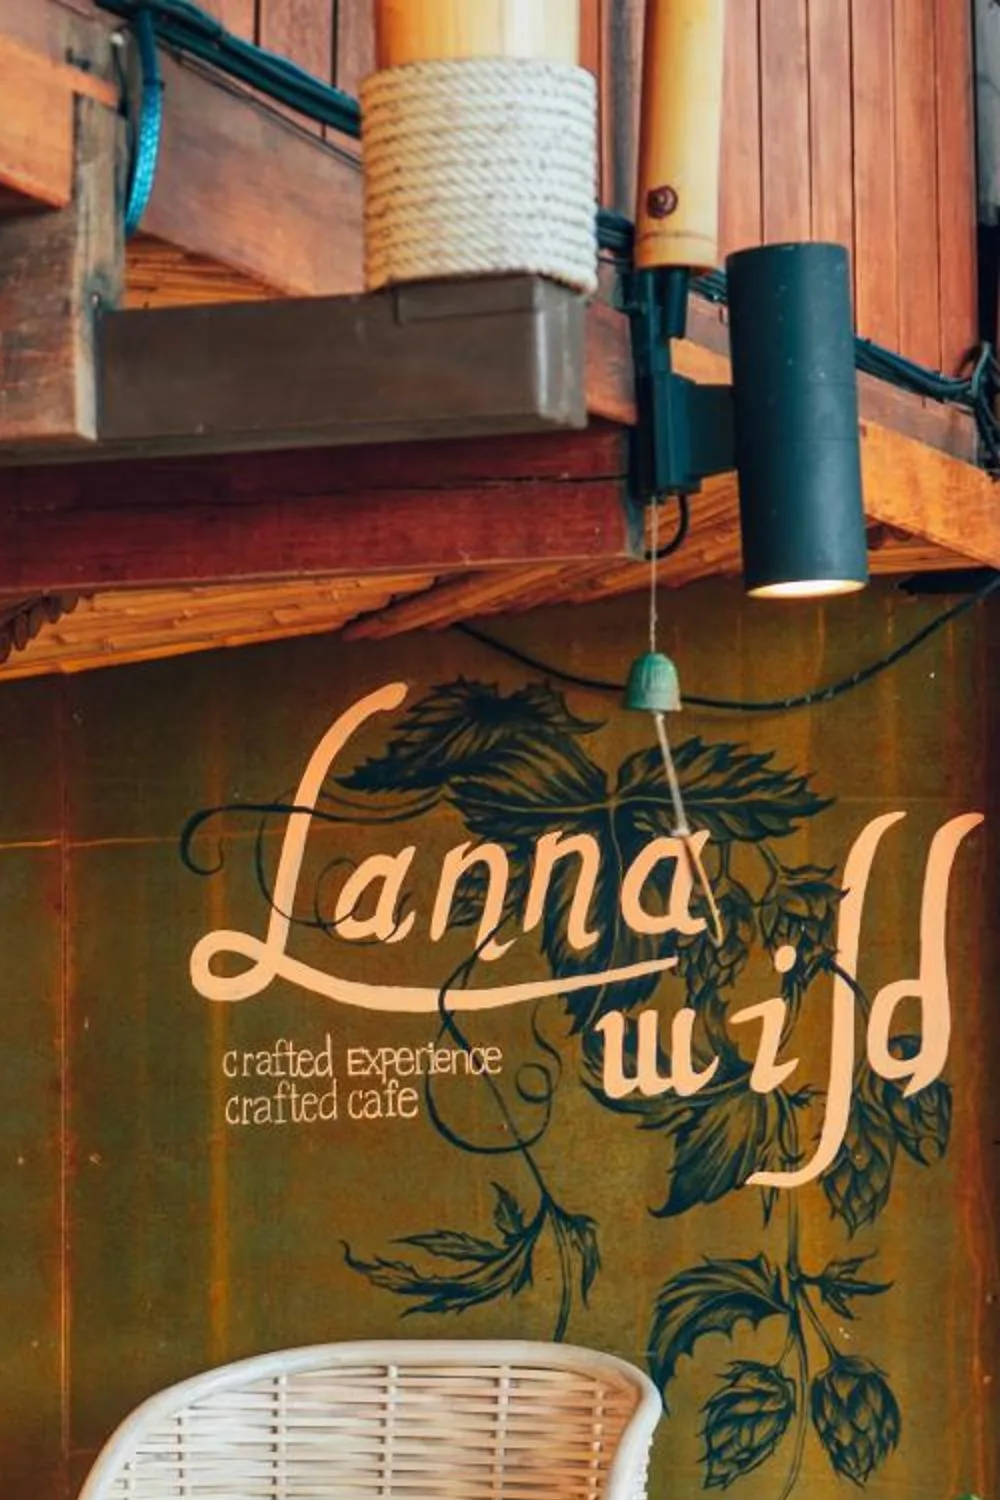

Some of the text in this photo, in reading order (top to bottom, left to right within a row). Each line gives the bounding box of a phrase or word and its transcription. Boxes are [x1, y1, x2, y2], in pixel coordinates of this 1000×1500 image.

[190, 682, 710, 1013] Lanna
[222, 1032, 333, 1079] crafted
[596, 811, 985, 1188] wild
[225, 1078, 419, 1125] crafted cafe
